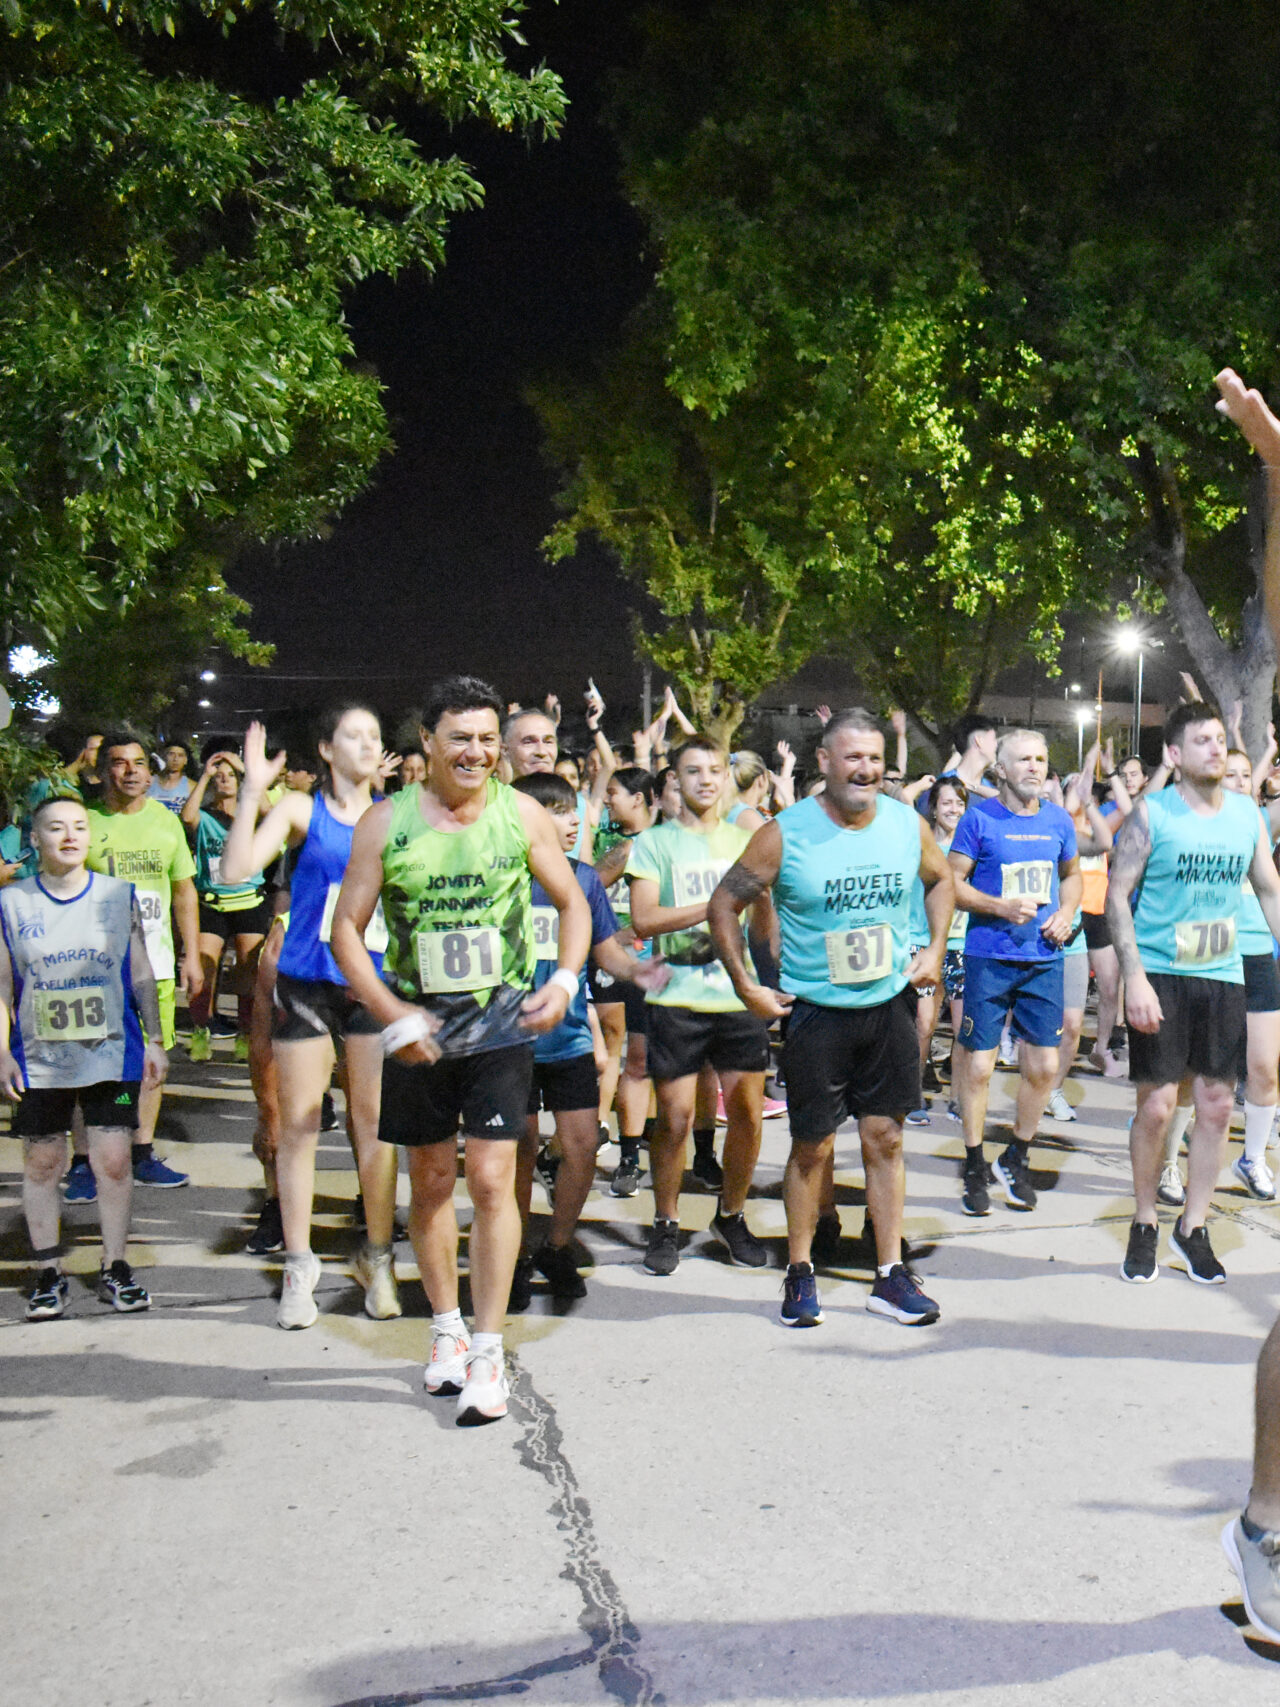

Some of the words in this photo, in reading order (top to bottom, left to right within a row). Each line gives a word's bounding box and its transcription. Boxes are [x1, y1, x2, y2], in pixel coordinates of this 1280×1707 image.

[118, 860, 163, 875] RUNNING
[488, 855, 519, 870] JRT
[426, 874, 487, 890] JOVITA
[824, 872, 902, 894] MOVETE
[1014, 866, 1051, 894] 187
[419, 896, 494, 914] RUNNING
[846, 927, 884, 972] 37
[1192, 922, 1229, 958] 70
[43, 948, 114, 970] MARATON
[442, 931, 493, 979] 81
[33, 977, 77, 991] ADELIA
[47, 996, 106, 1030] 313
